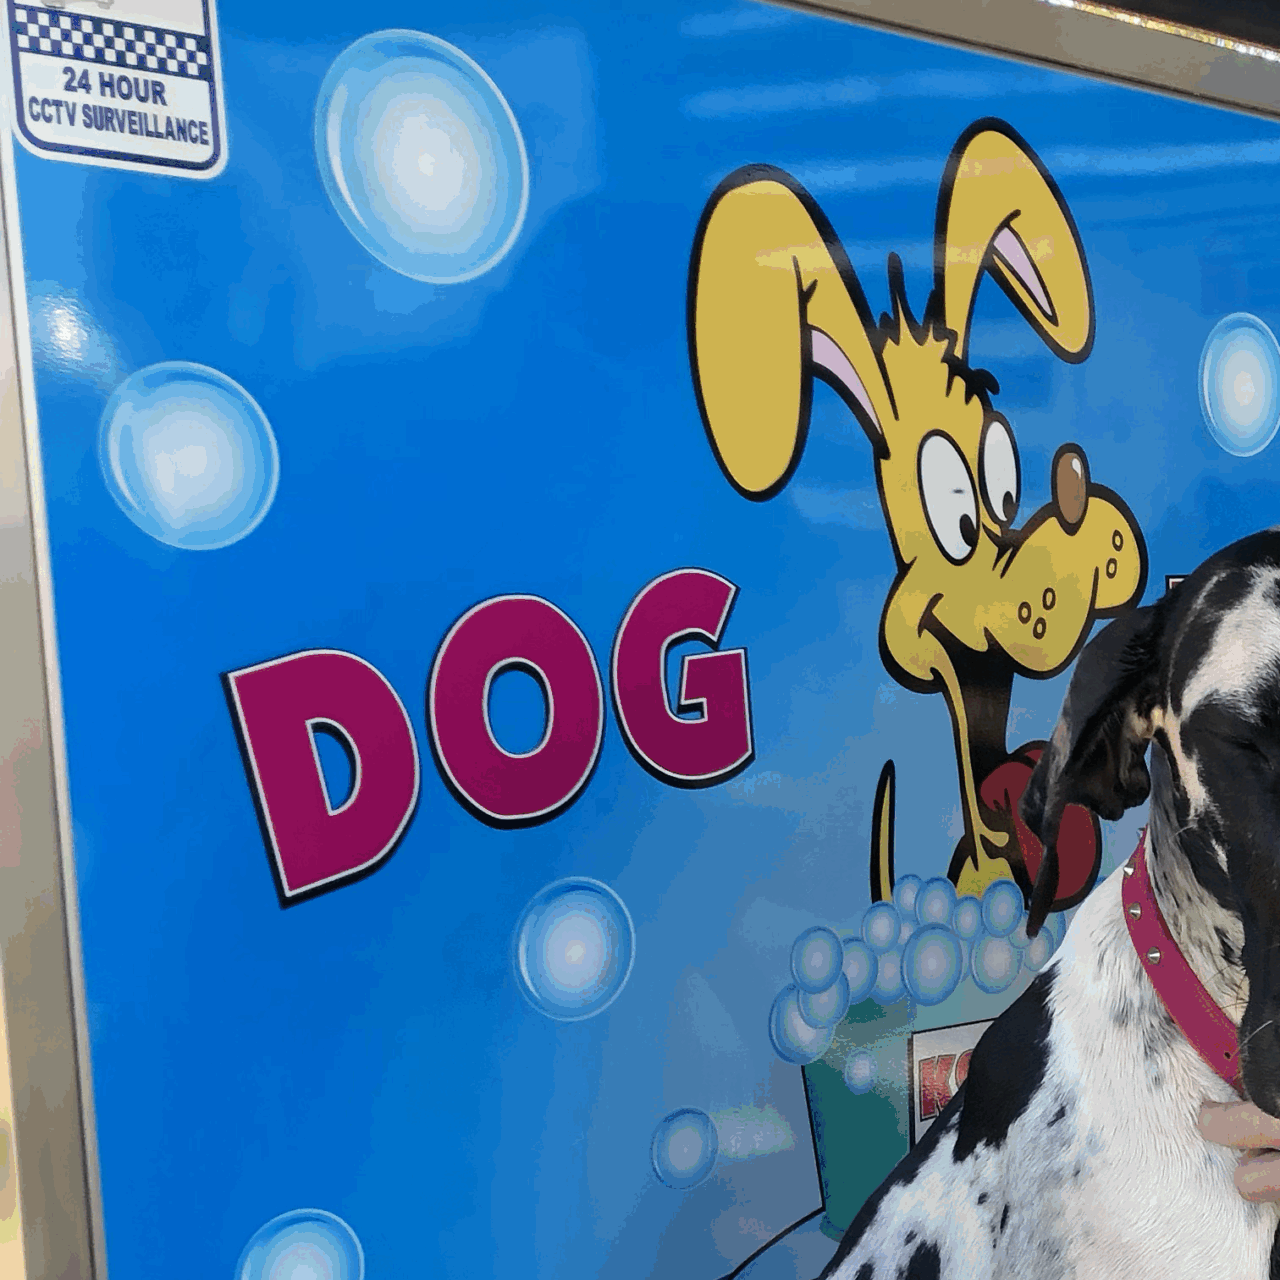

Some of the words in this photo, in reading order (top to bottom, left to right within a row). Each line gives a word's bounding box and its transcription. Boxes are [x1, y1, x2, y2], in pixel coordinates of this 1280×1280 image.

[62, 66, 92, 94] 24
[98, 71, 168, 106] HOUR
[28, 95, 77, 126] CCTV
[82, 103, 210, 146] SURVEILLANCE
[220, 567, 756, 910] DOG
